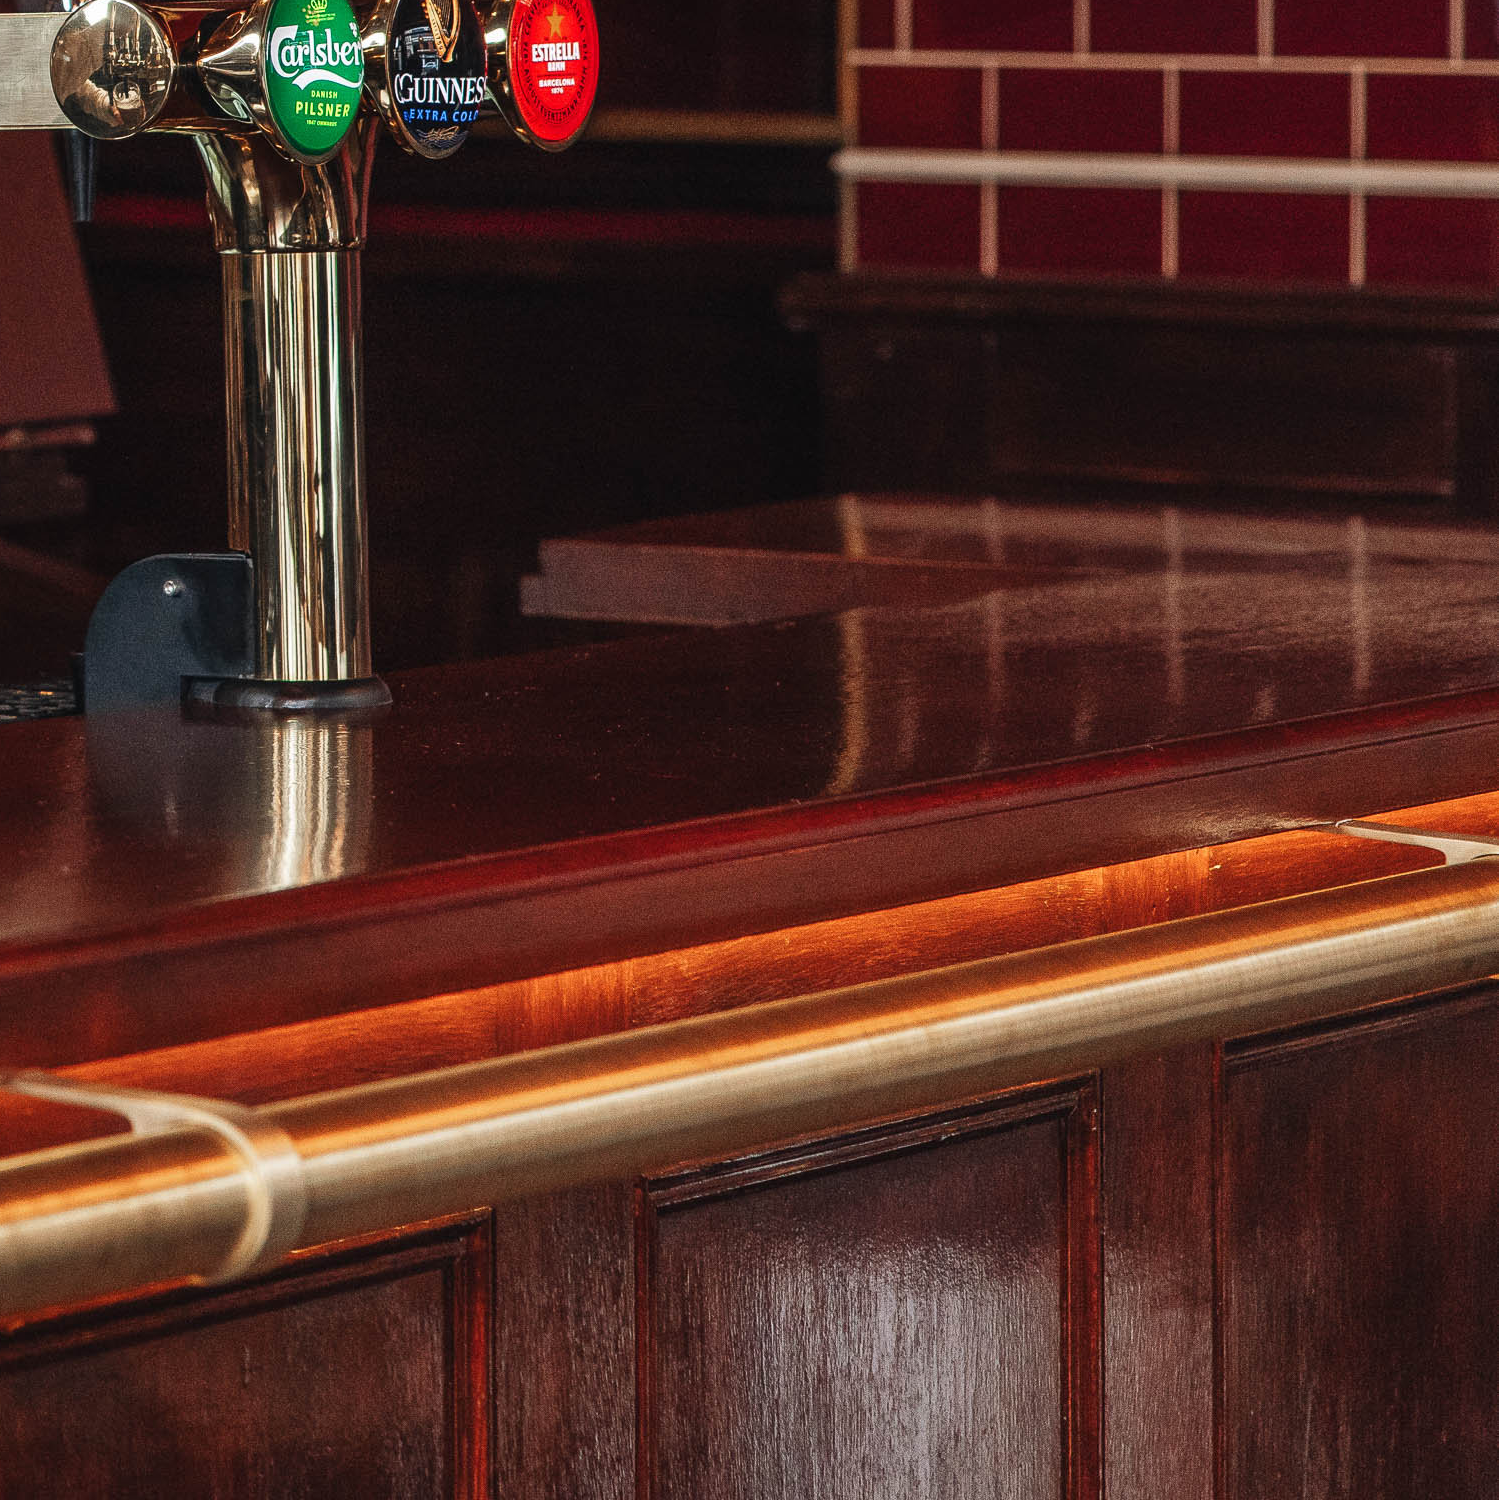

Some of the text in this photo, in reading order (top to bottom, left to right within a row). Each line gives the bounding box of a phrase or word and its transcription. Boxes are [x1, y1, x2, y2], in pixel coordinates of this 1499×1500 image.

[270, 25, 365, 77] Carlsber
[532, 42, 580, 62] ESTRELLA
[394, 73, 489, 105] GUINNES
[538, 78, 575, 88] BARCELONA
[311, 90, 338, 99] DANISH
[295, 101, 351, 117] PILSNER
[409, 108, 448, 122] EXTRA
